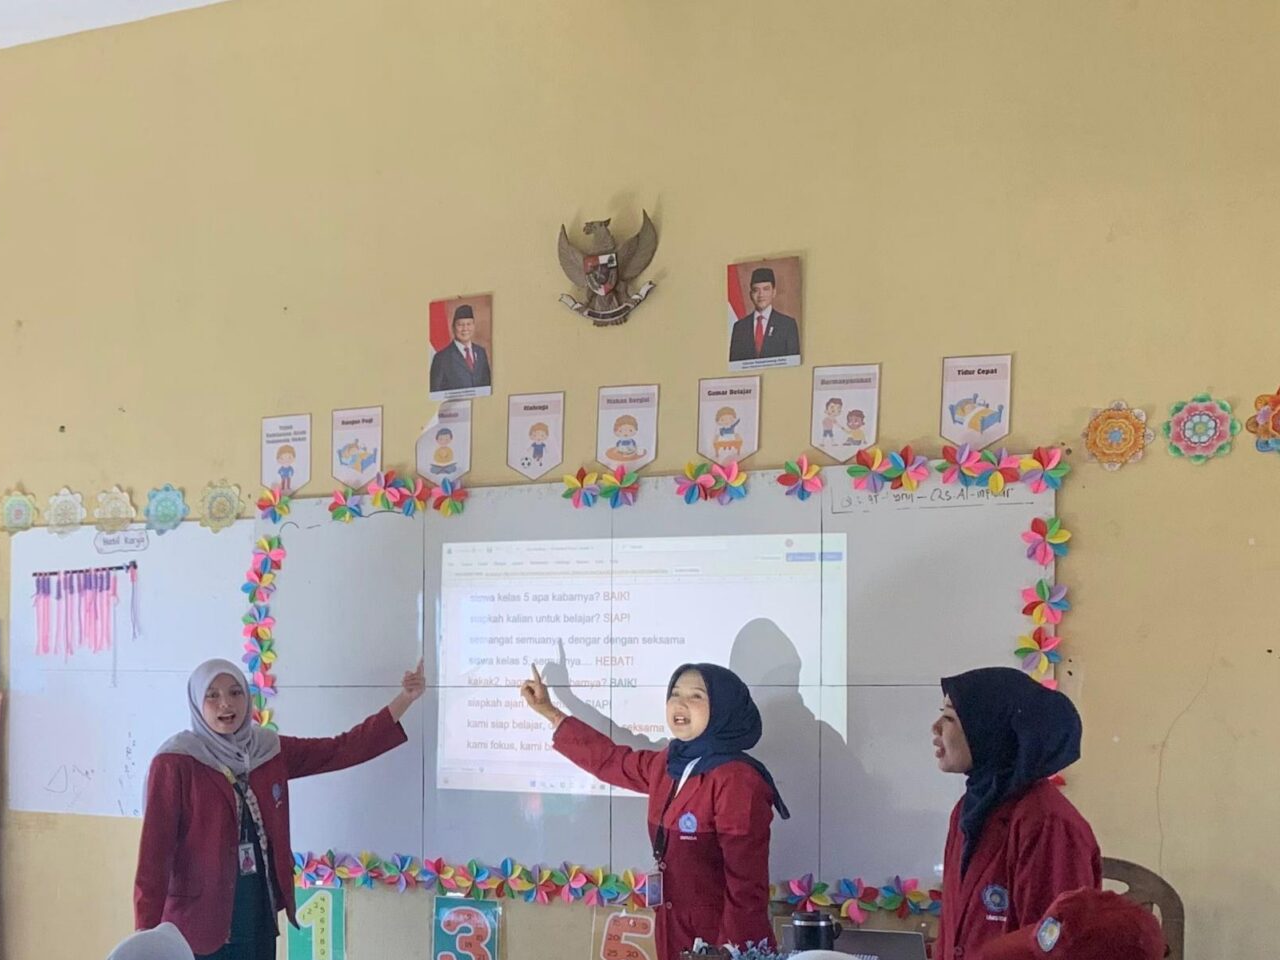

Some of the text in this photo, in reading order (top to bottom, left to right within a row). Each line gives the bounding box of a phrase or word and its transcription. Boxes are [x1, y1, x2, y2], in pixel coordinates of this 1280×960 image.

[976, 368, 998, 376] Cepat
[729, 388, 752, 397] Belajar
[497, 592, 521, 602] kelas
[523, 592, 530, 602] 5
[532, 595, 549, 604] apa
[506, 613, 533, 623] kalian
[535, 613, 561, 623] untuk
[563, 613, 600, 625] belajar?
[567, 635, 601, 647] dengar
[603, 635, 639, 647] dengan
[641, 635, 685, 645] seksama
[495, 656, 520, 666] kelas
[467, 720, 489, 729] kami
[490, 720, 510, 731] siap
[467, 741, 488, 750] kami
[520, 743, 542, 752] kami
